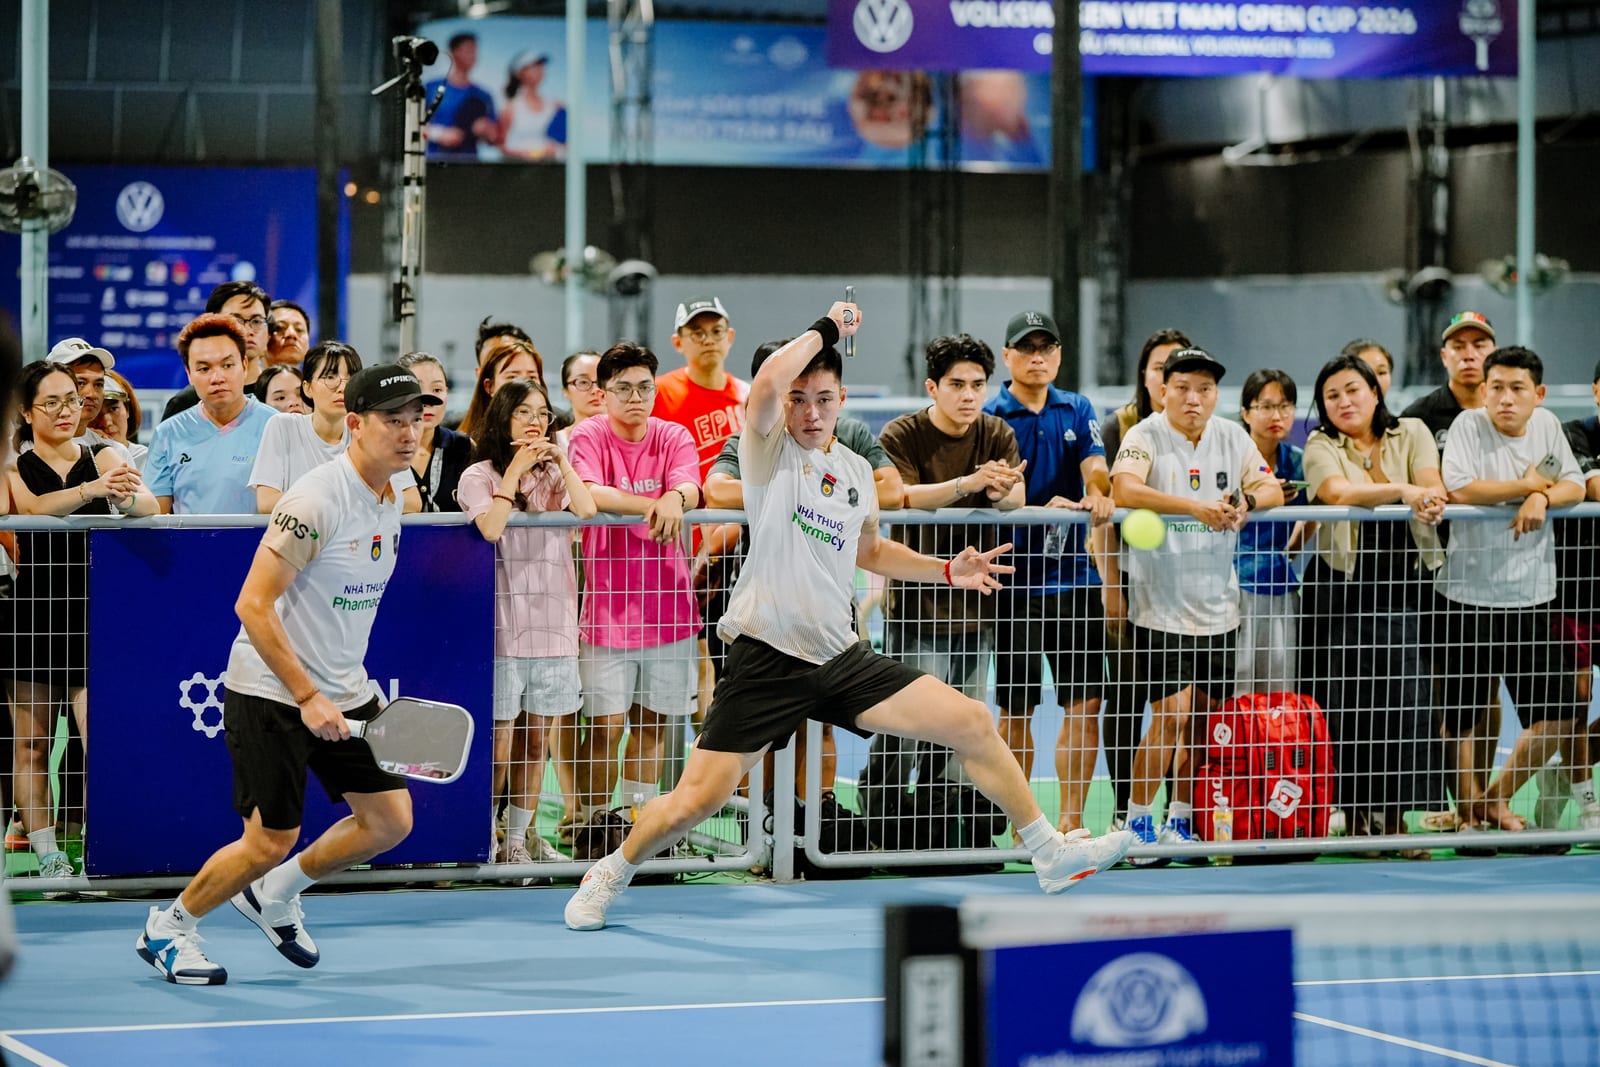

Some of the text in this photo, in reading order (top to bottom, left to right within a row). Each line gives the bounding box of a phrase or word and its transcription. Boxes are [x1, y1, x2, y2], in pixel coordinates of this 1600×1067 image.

[949, 1, 1122, 29] VOLKSWEN
[1178, 3, 1237, 31] NAM
[1237, 4, 1306, 32] OPEN
[1307, 5, 1356, 33] CUP
[343, 582, 364, 595] NHÀ
[332, 596, 381, 611] Pharmac
